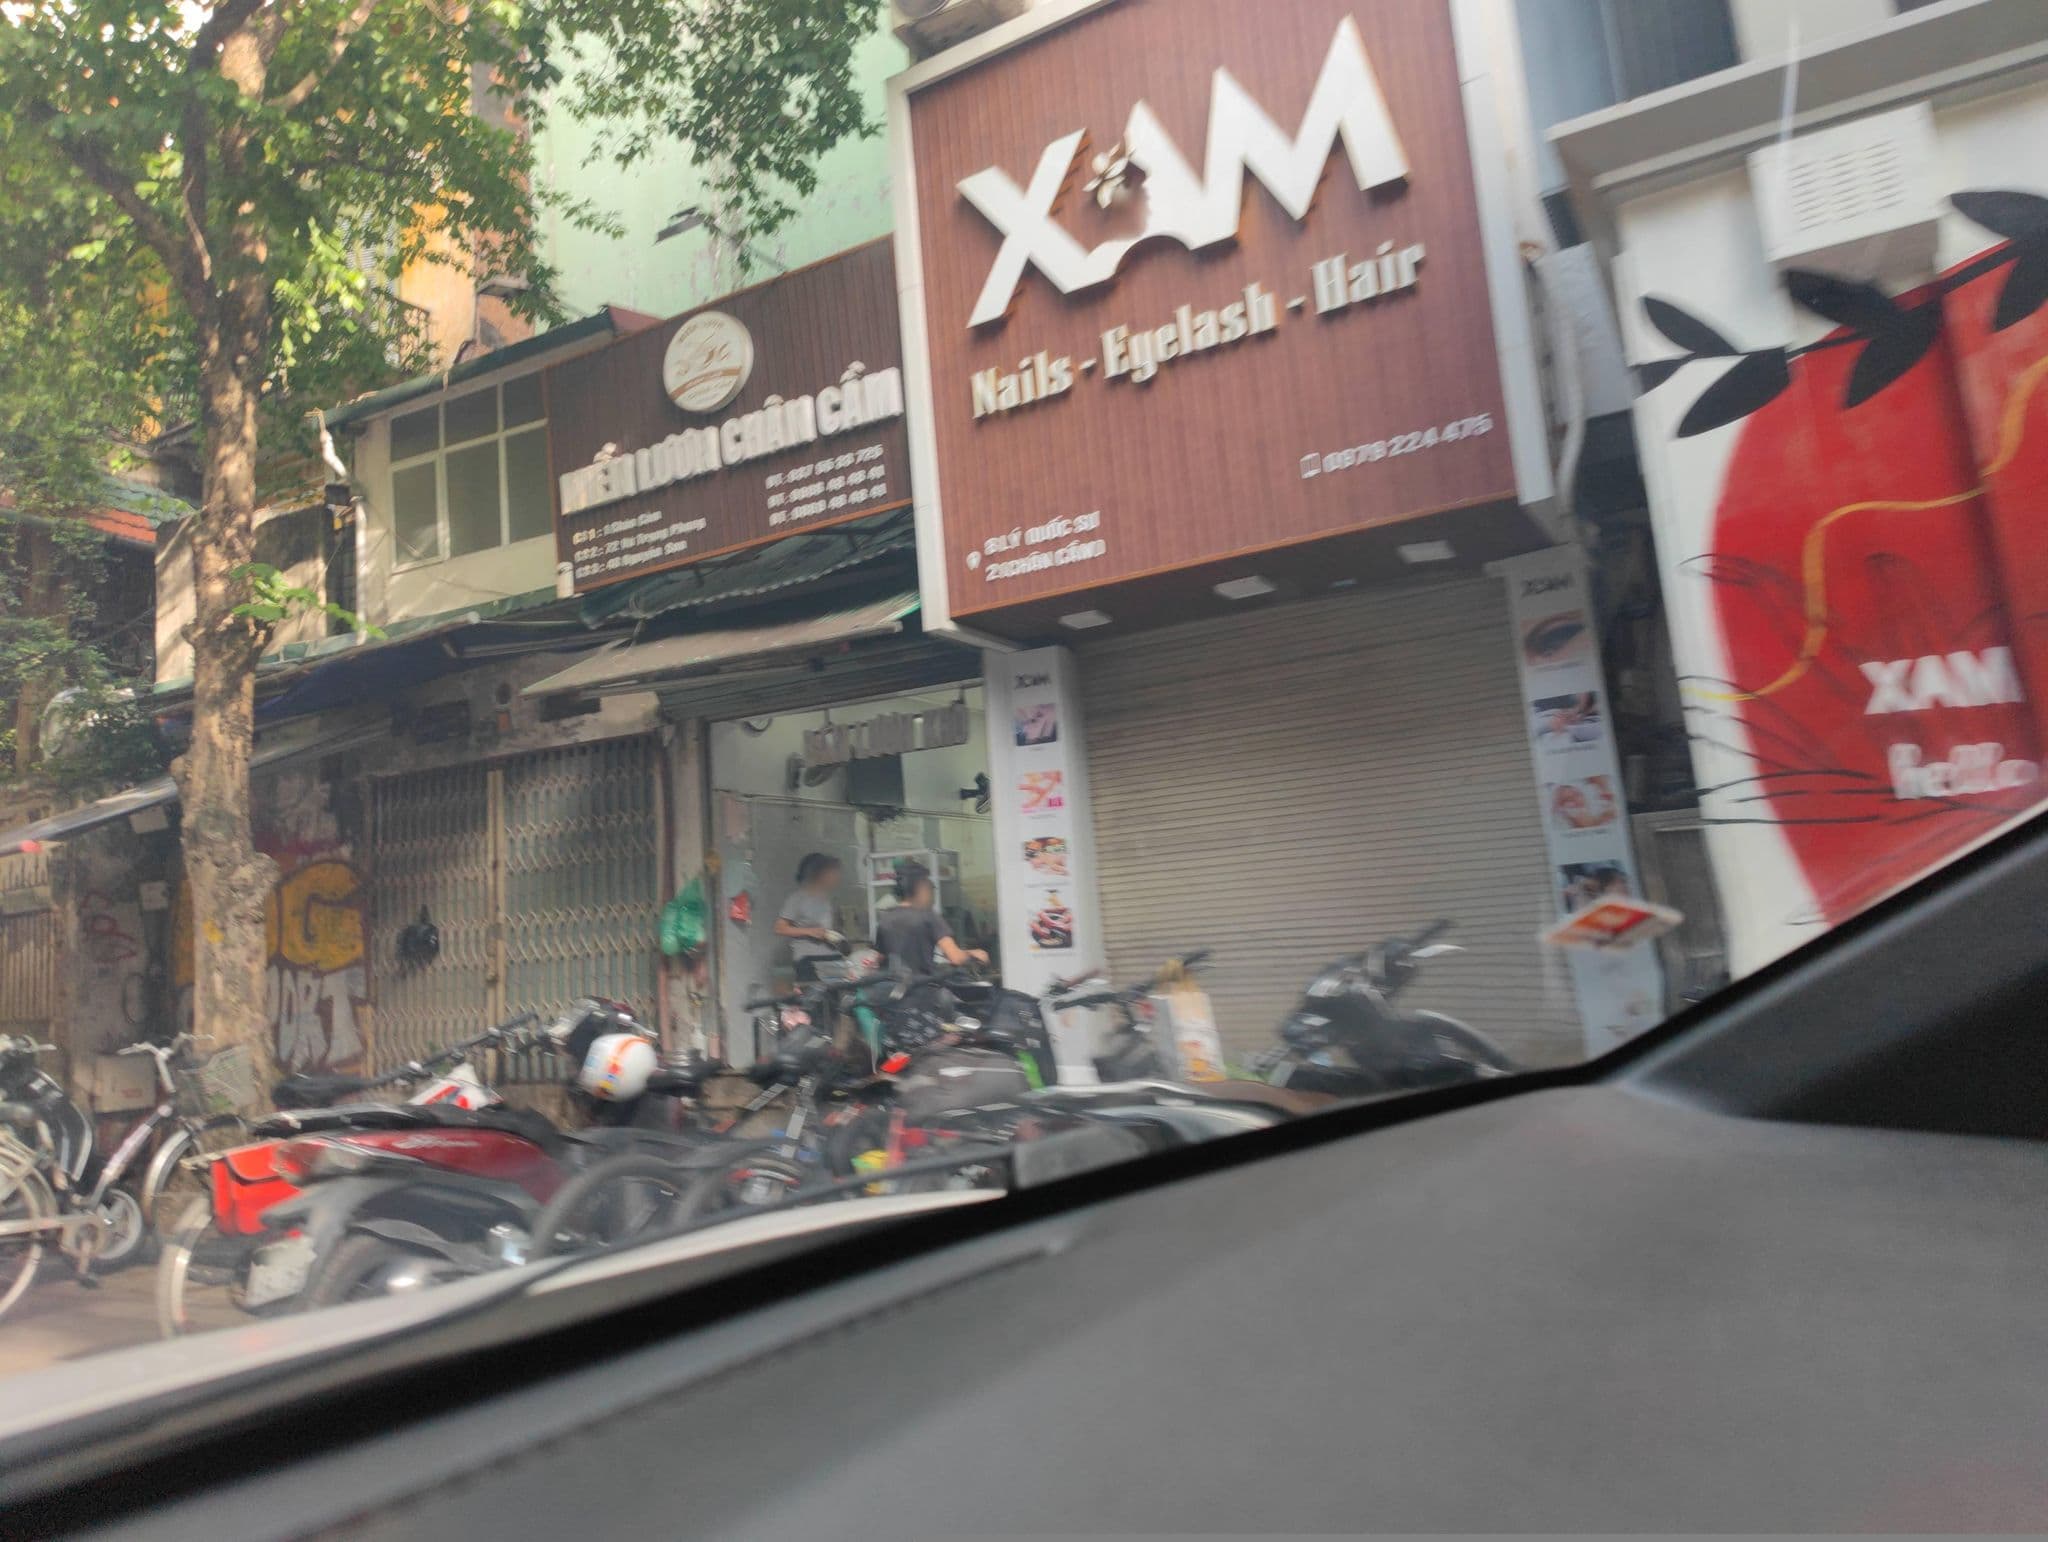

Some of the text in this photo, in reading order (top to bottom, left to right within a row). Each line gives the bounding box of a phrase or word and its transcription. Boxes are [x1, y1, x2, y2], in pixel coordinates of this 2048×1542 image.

[957, 13, 1411, 330] XAM
[972, 349, 1074, 419] Nails
[1101, 281, 1279, 384] Eyelash
[1312, 239, 1427, 315] Hair
[1857, 646, 2023, 716] XAM
